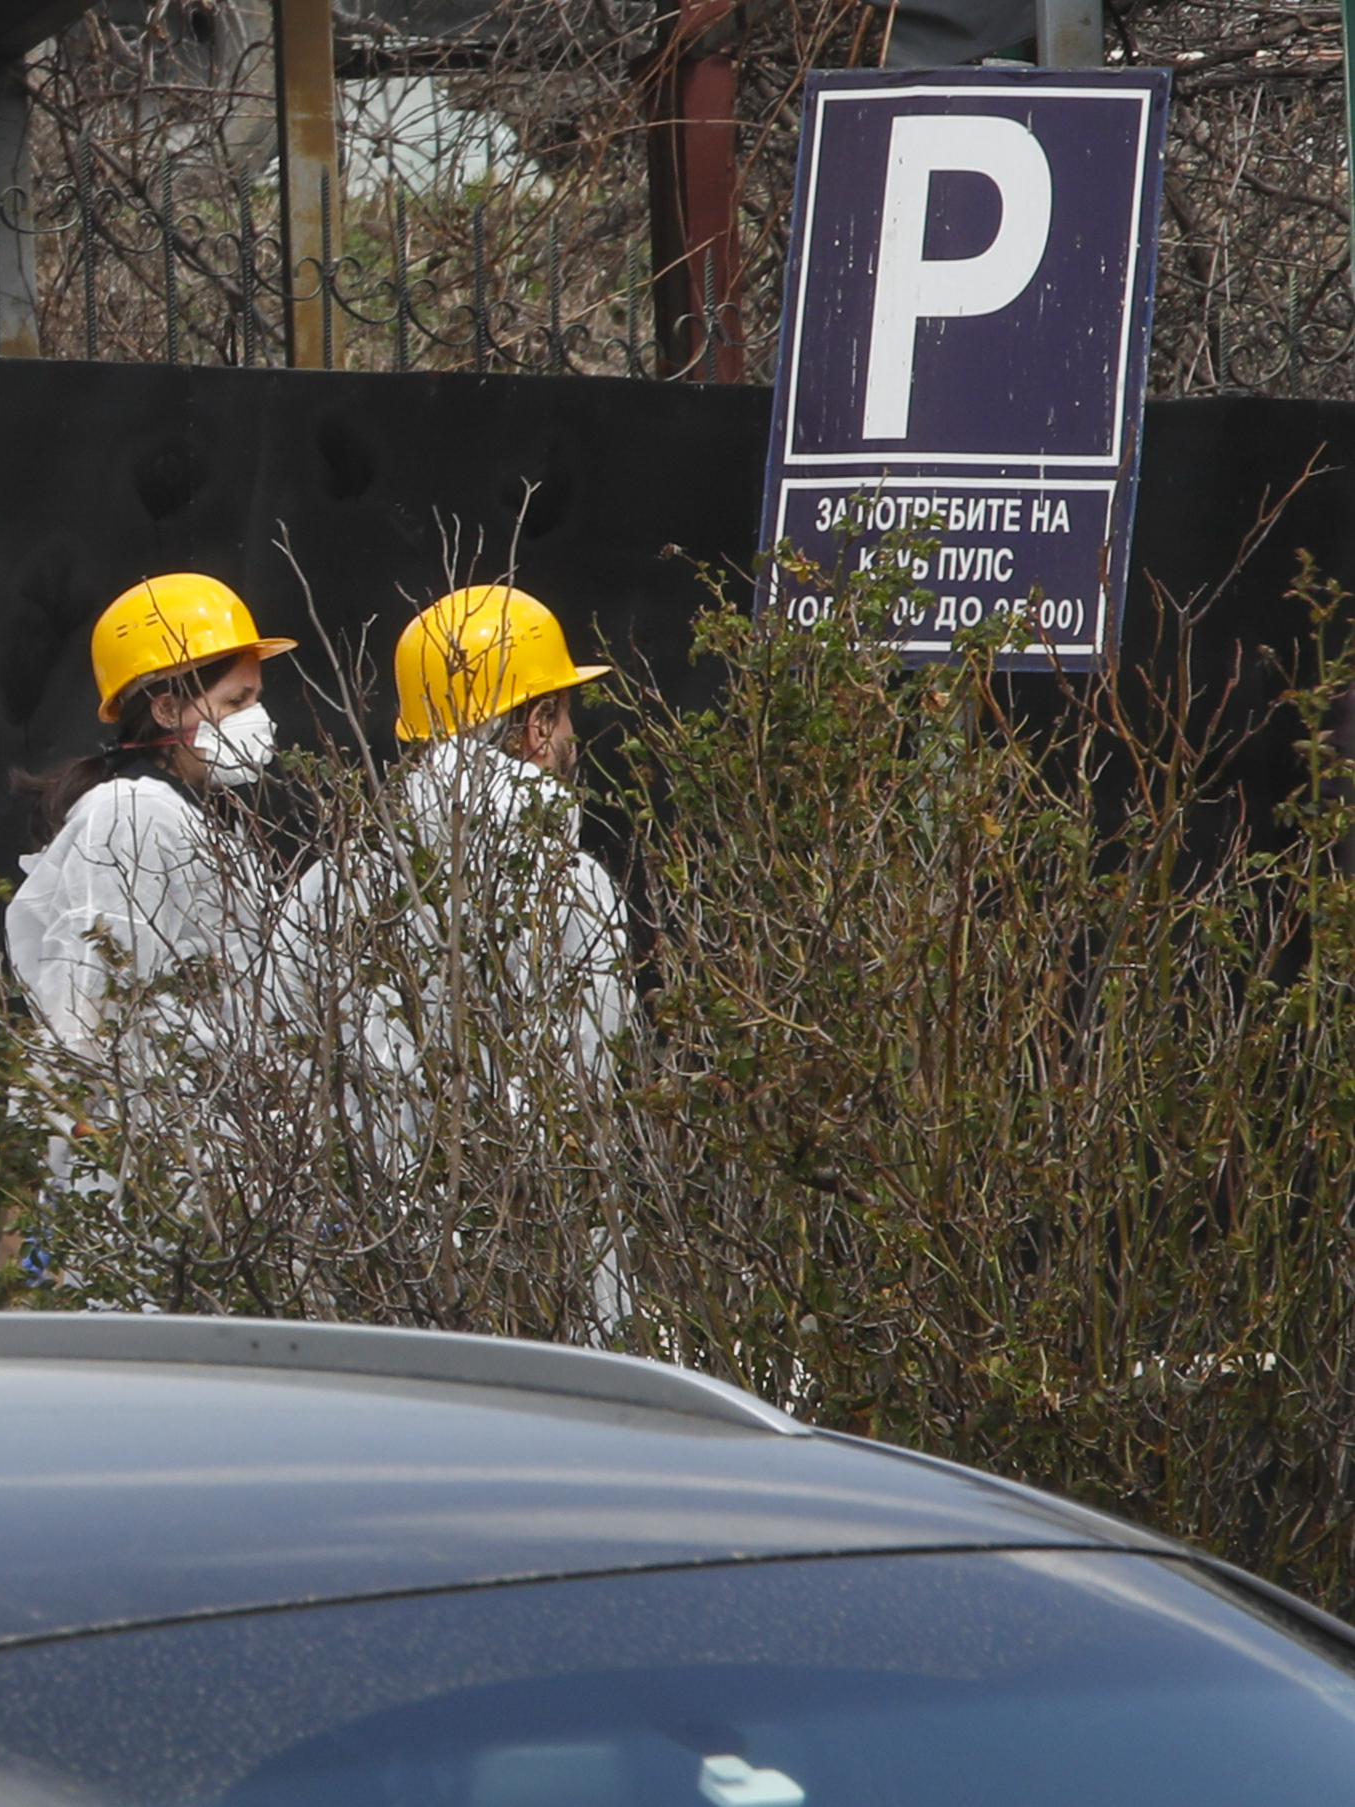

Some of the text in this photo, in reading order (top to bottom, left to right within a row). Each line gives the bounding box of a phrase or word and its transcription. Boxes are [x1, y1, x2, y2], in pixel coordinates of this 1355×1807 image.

[862, 114, 1053, 440] P
[815, 496, 1071, 533] ЗА ПОТРЕБИТЕ НА
[858, 546, 1015, 582] КУБ ПУЛС
[933, 596, 983, 632] ДО
